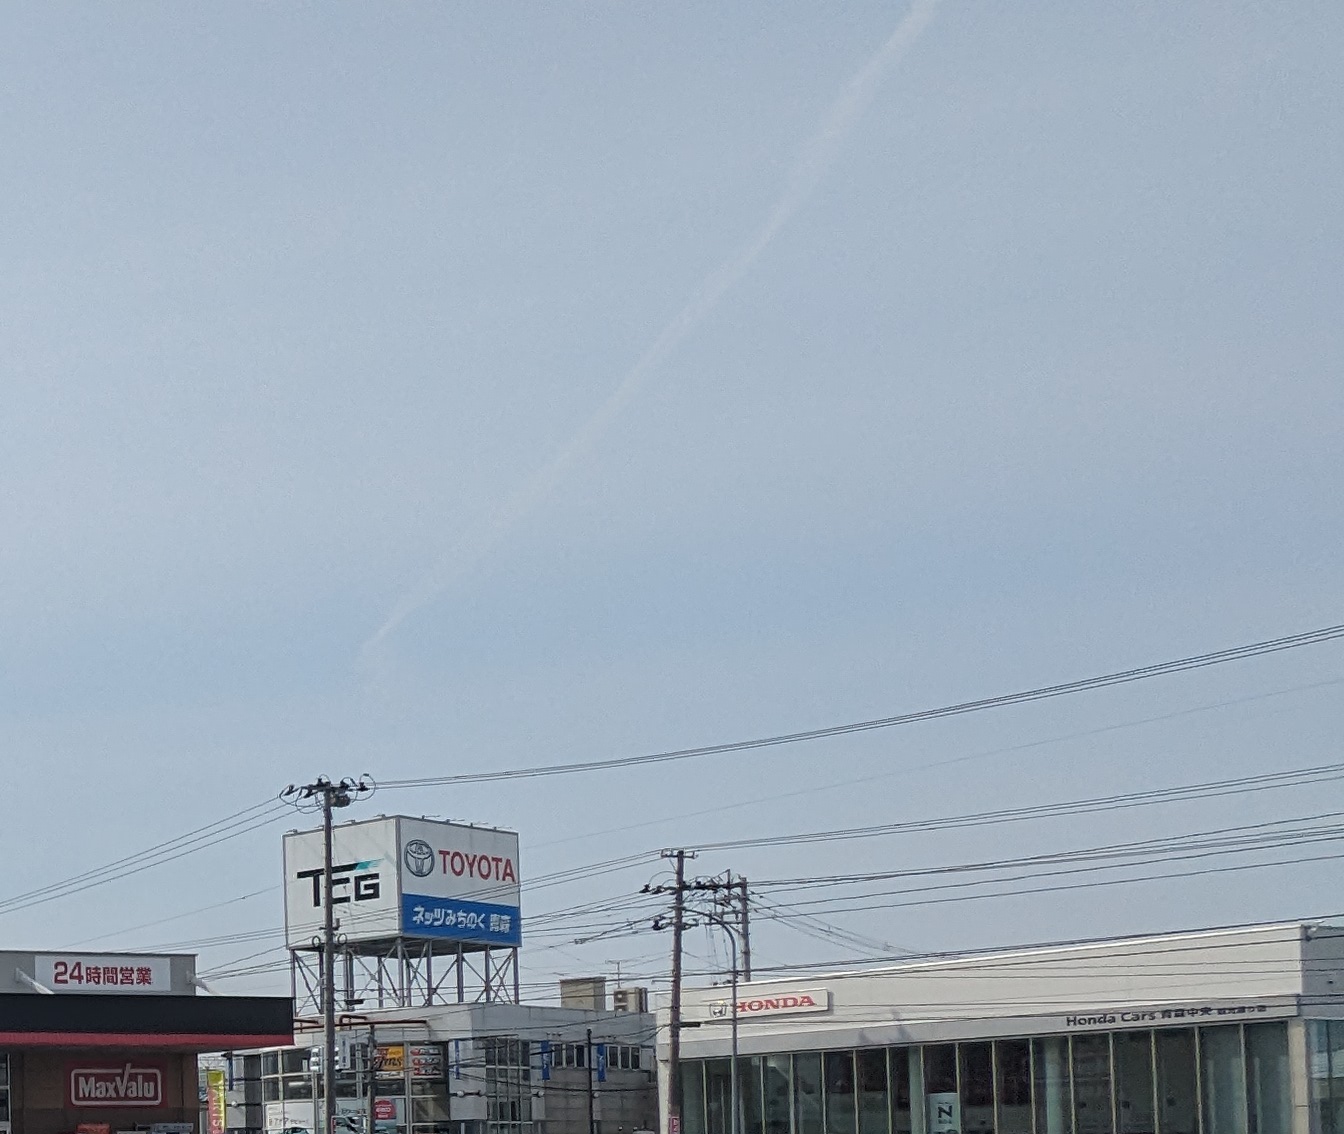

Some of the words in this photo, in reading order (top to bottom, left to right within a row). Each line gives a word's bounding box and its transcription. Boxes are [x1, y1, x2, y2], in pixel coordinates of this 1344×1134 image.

[438, 849, 517, 883] TOYOTA
[53, 961, 152, 985] 24時間営業
[733, 994, 817, 1013] HONDA
[1066, 1012, 1116, 1026] Honda
[1121, 1011, 1156, 1022] Cars
[78, 1062, 155, 1099] MaxValu
